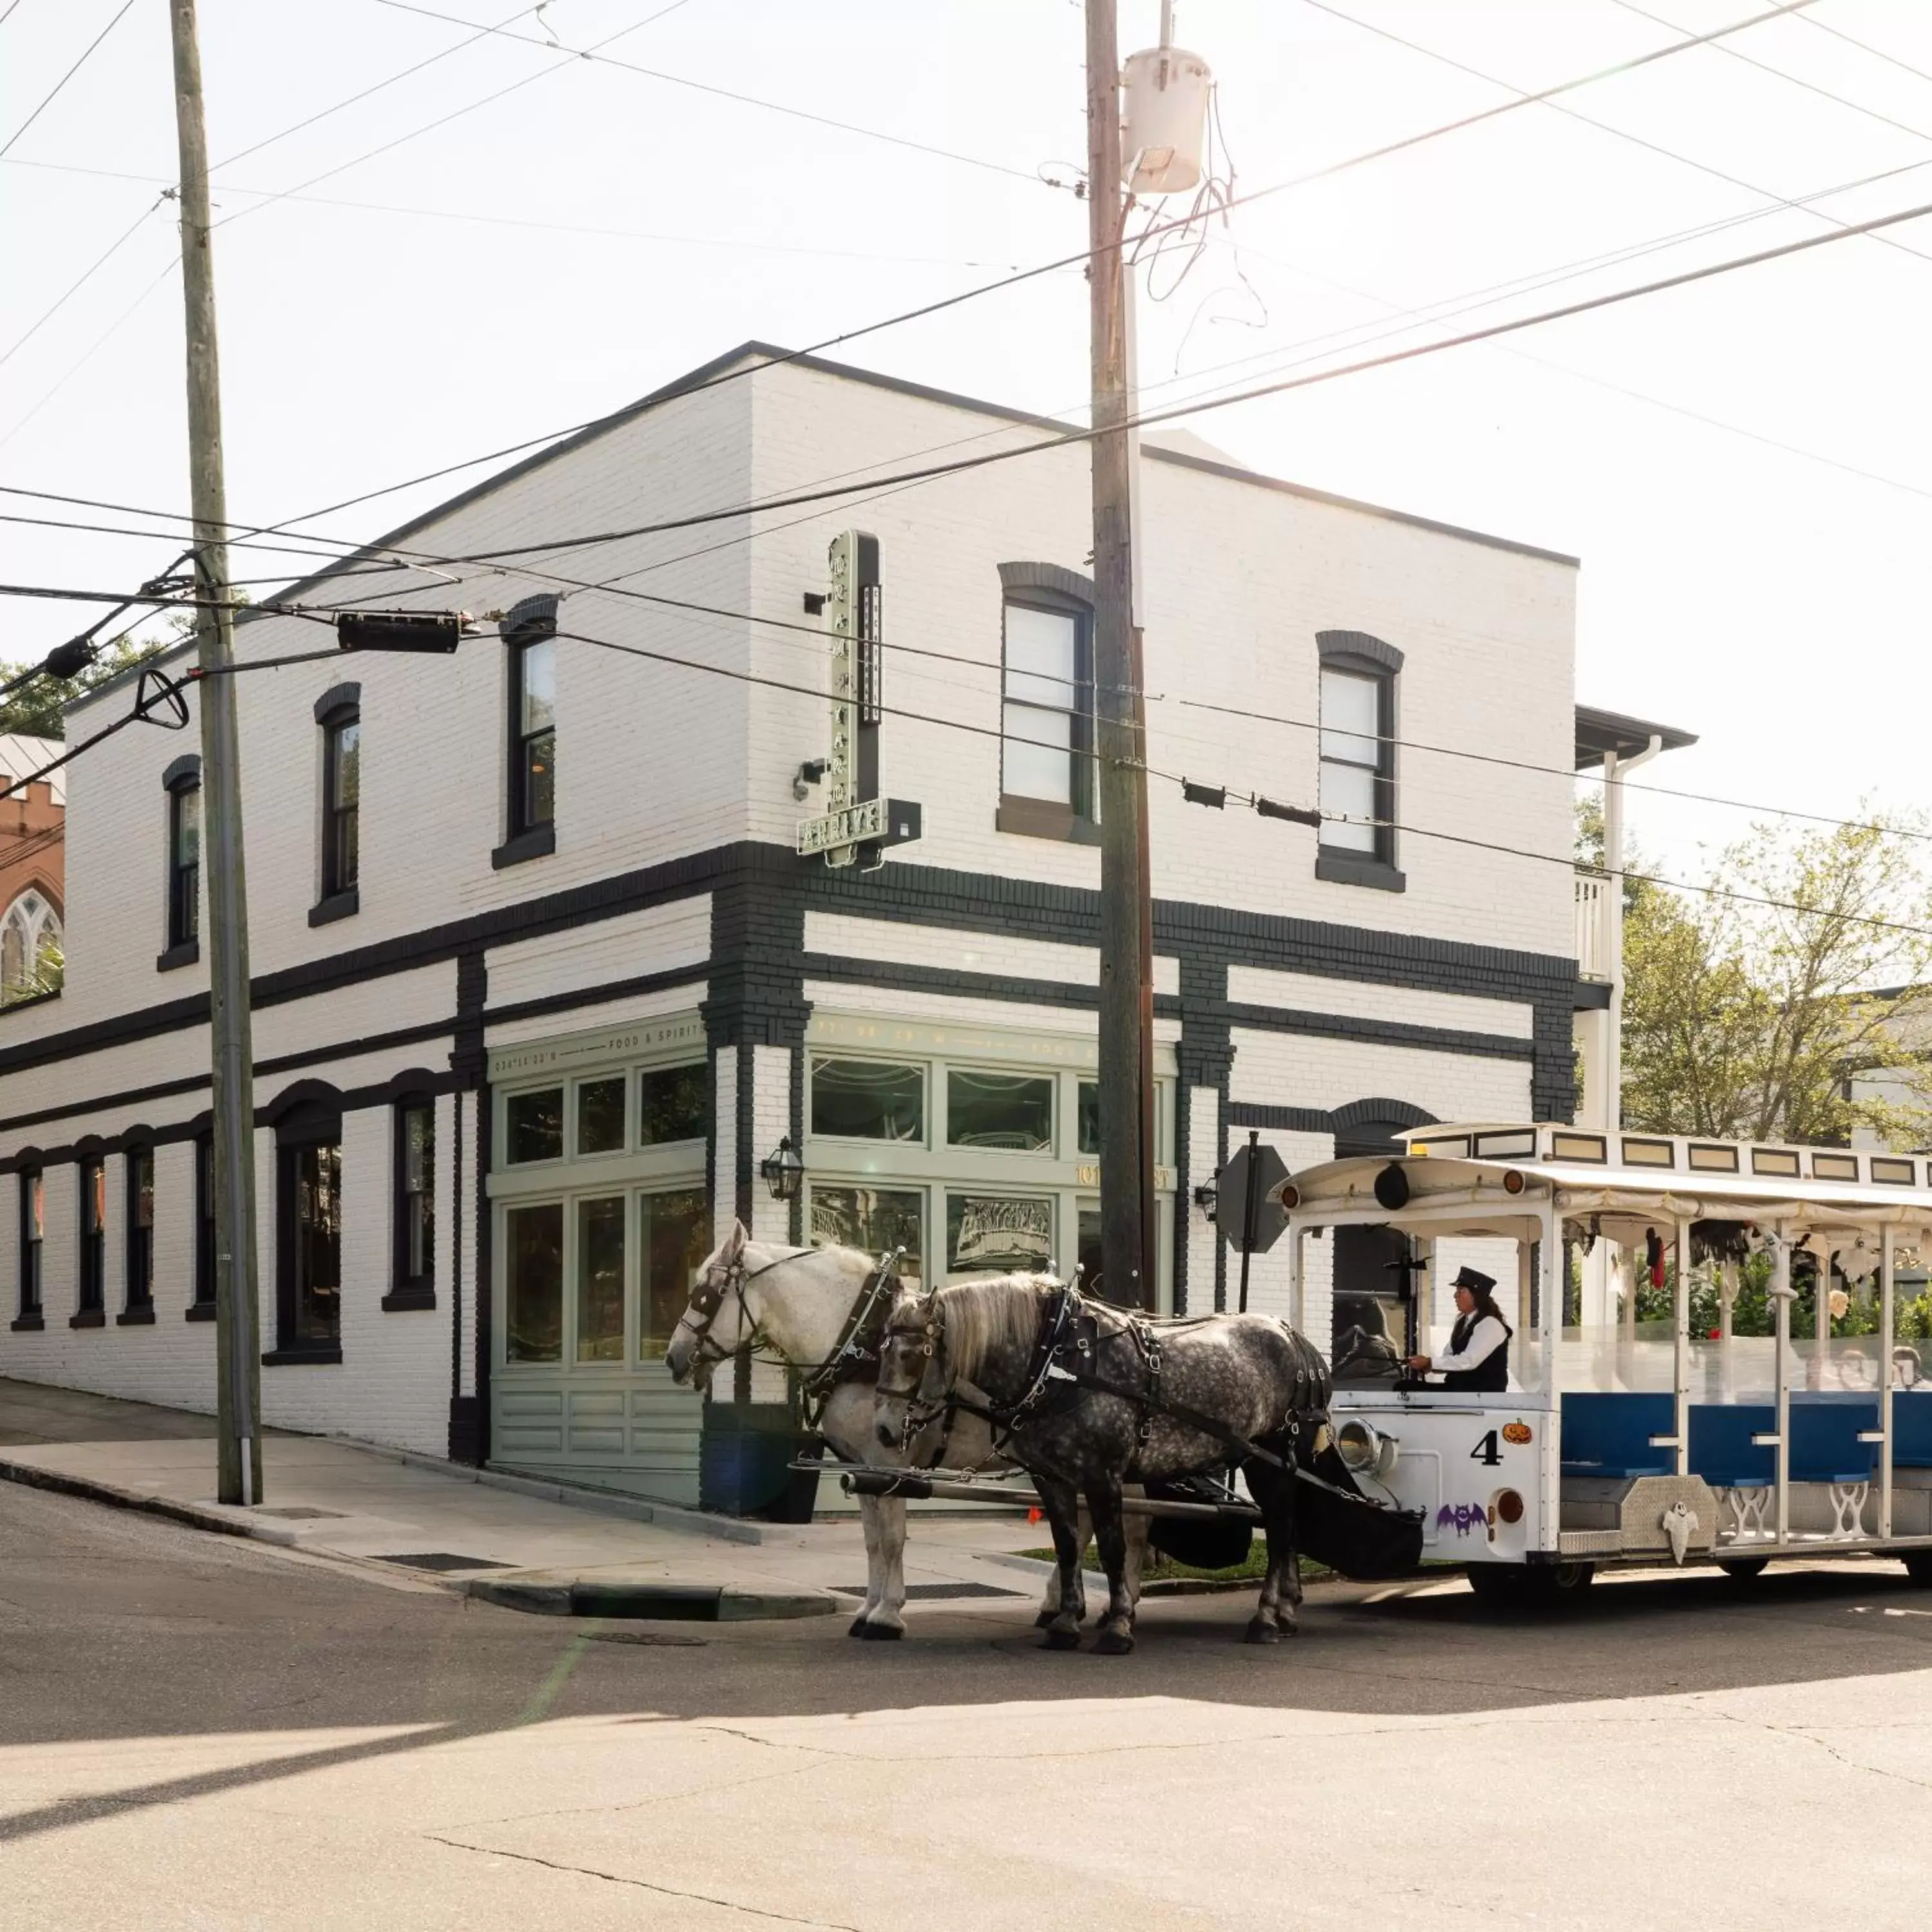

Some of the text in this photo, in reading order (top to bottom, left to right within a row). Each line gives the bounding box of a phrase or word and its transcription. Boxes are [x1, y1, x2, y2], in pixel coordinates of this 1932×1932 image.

[804, 804, 878, 846] ARRIVE
[609, 1035, 638, 1048] FOOD
[1470, 1430, 1504, 1466] 4
